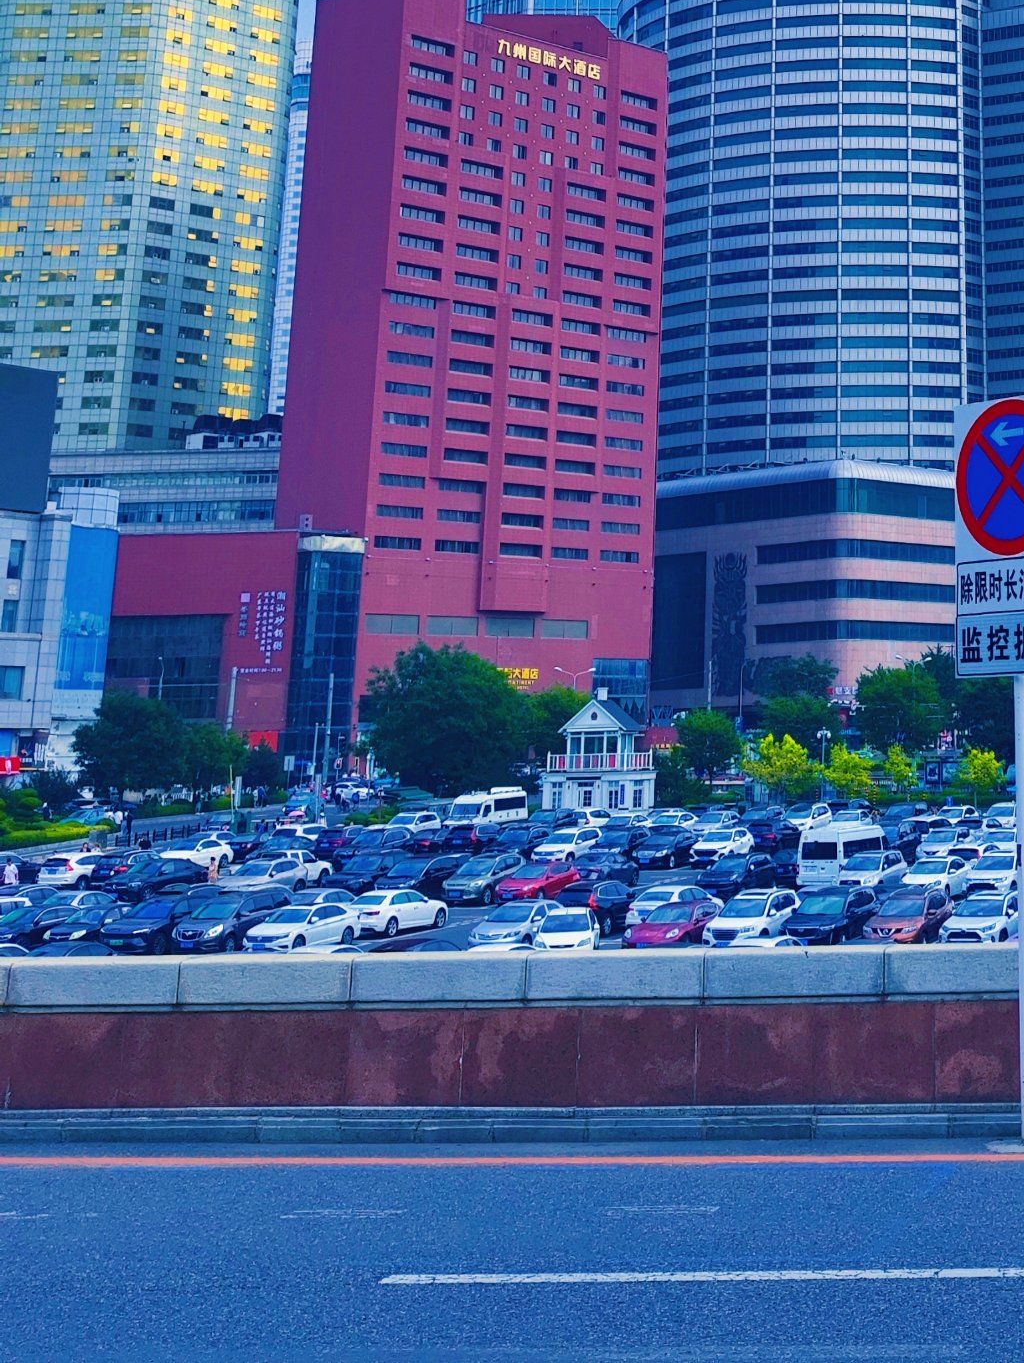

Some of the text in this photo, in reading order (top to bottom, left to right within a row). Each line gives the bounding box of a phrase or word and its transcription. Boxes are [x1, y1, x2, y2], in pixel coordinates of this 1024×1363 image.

[497, 38, 602, 81] 九州国际大酒店
